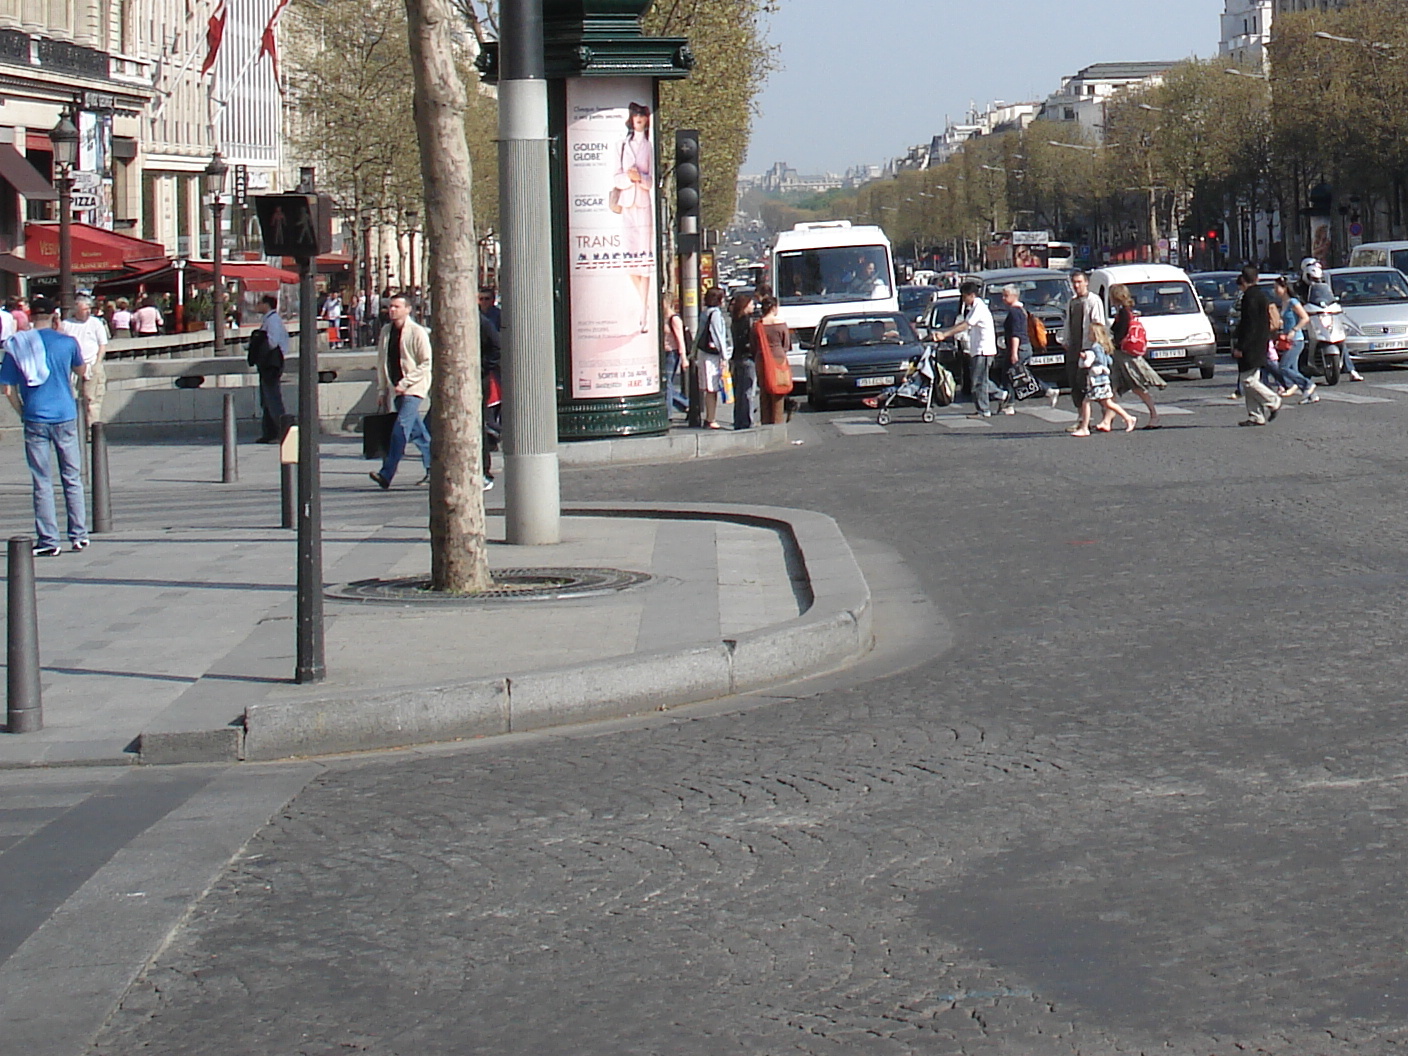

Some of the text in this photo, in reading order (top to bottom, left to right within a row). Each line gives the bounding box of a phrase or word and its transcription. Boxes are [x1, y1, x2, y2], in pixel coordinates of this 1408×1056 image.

[573, 143, 608, 152] GOLDEN
[573, 153, 601, 161] GLOBE
[69, 196, 96, 207] PIZZA
[574, 198, 604, 207] OSCAR
[575, 235, 621, 249] TRANS
